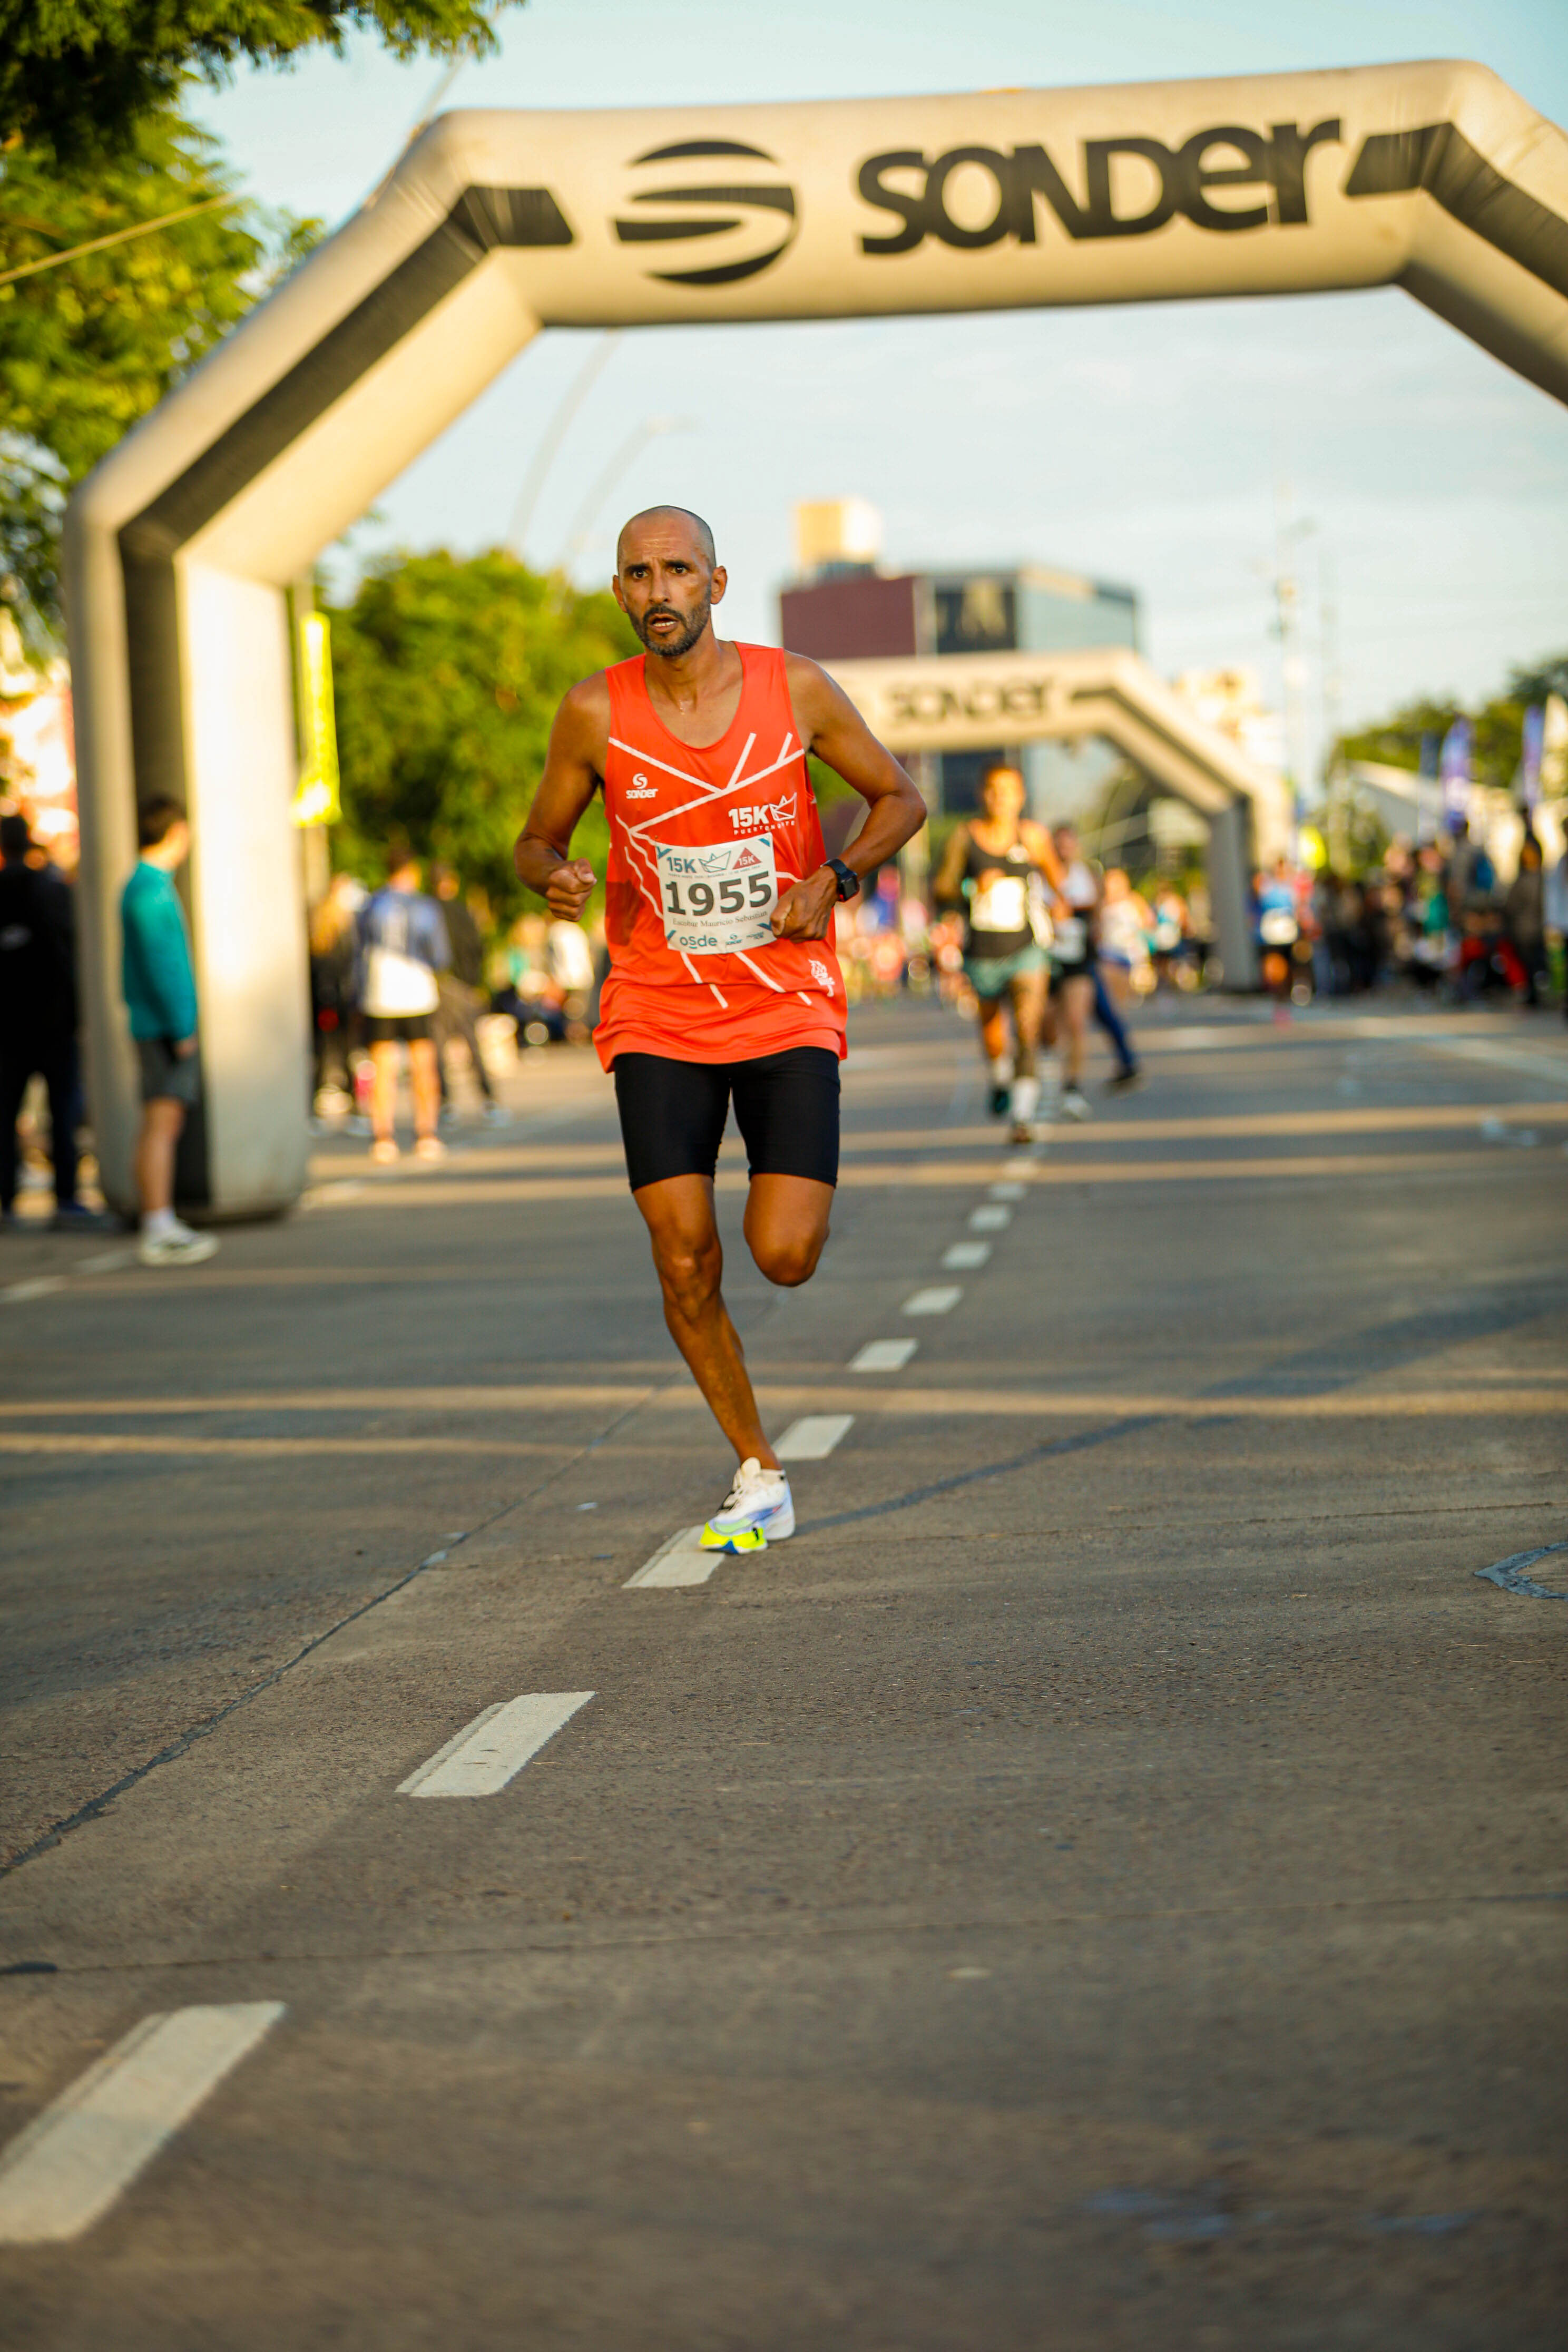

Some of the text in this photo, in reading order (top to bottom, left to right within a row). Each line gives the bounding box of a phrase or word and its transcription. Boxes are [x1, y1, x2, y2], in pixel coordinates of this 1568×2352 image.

[728, 805, 769, 828] 15K
[667, 856, 697, 873] 15K
[738, 855, 755, 866] 15K
[665, 870, 771, 916] 1955
[700, 919, 733, 927] Mauricio
[679, 934, 717, 948] osde
